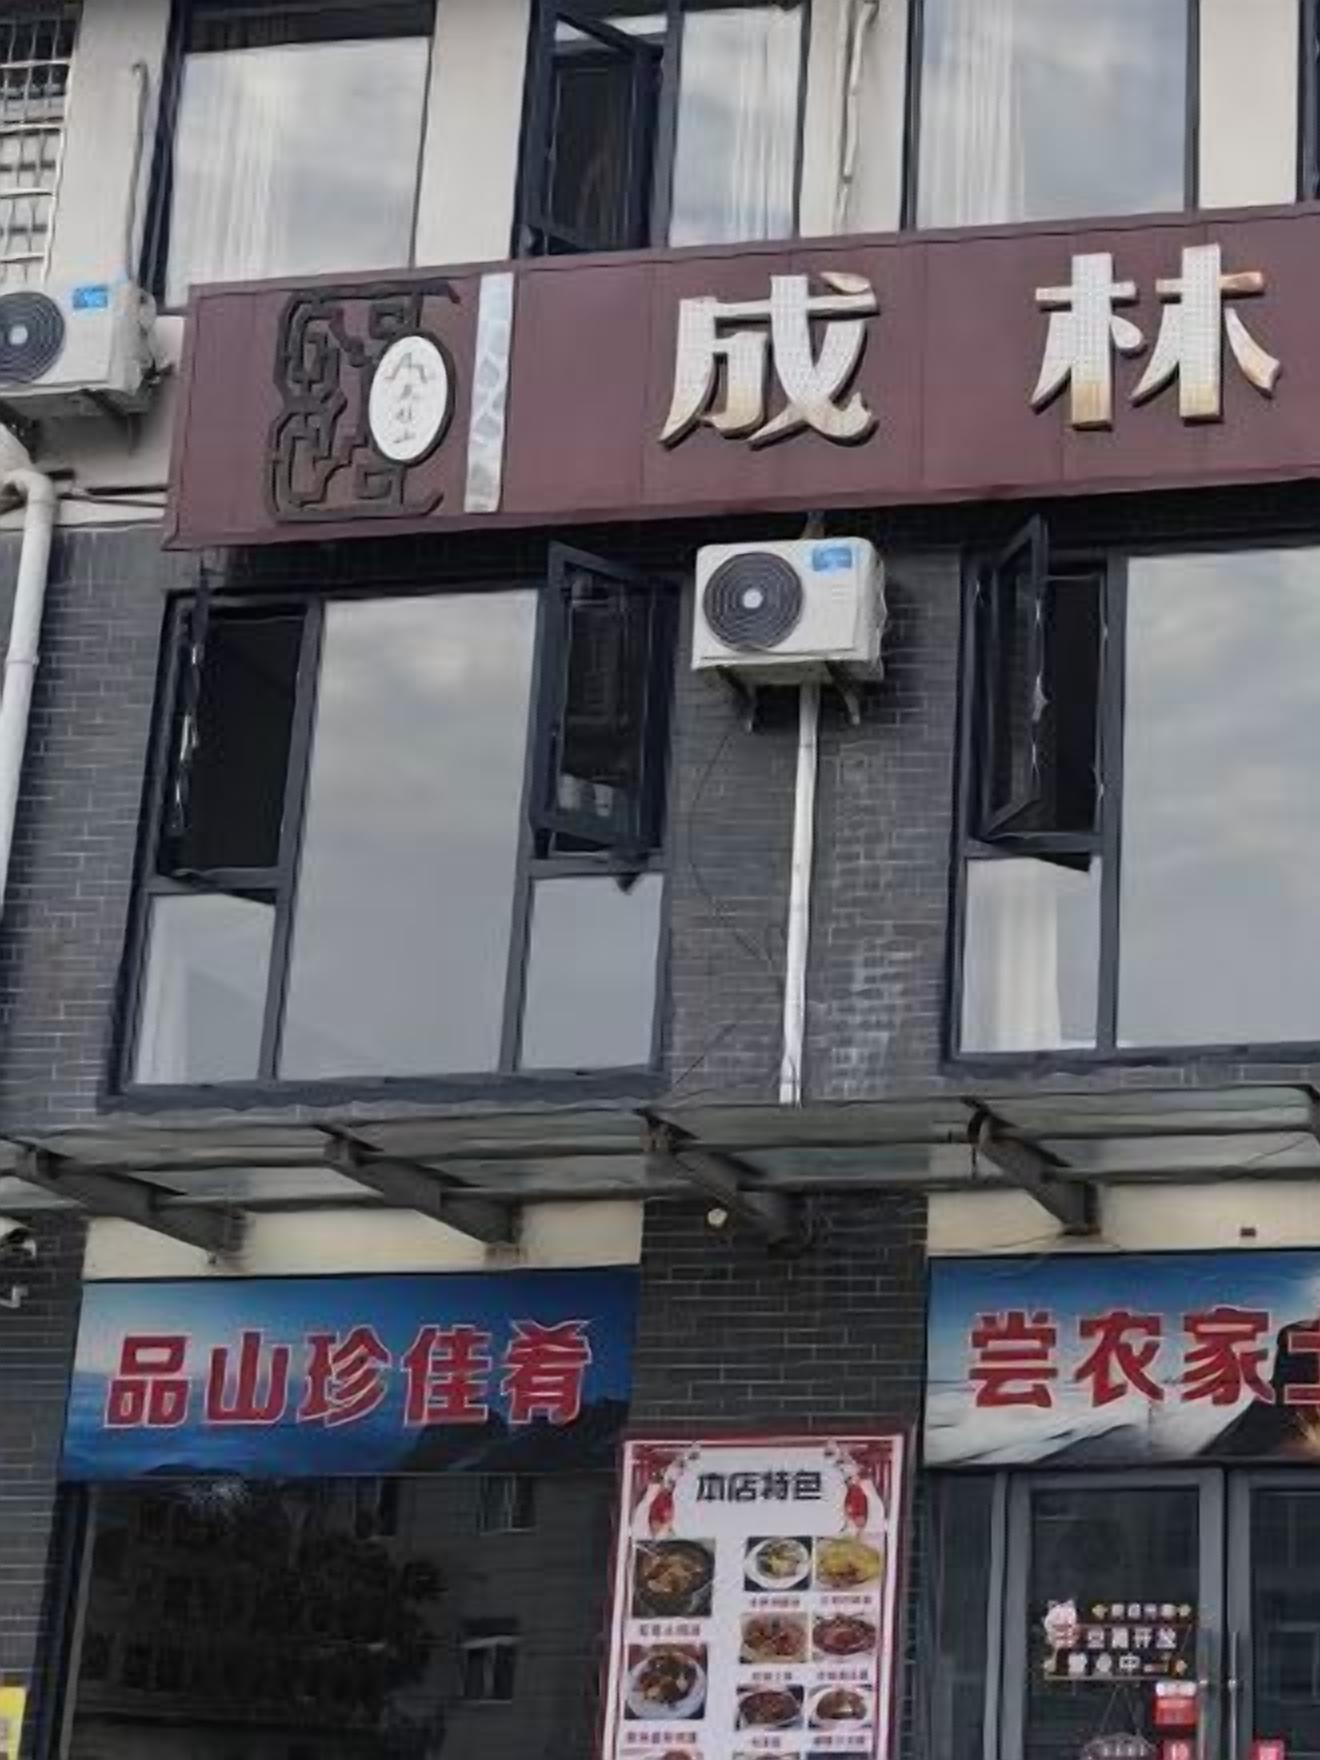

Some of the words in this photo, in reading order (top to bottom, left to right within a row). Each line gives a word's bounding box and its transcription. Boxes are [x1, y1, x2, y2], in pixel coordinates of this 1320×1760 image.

[102, 1318, 594, 1428] 品山珍佳肴
[695, 1470, 822, 1503] 本店特色
